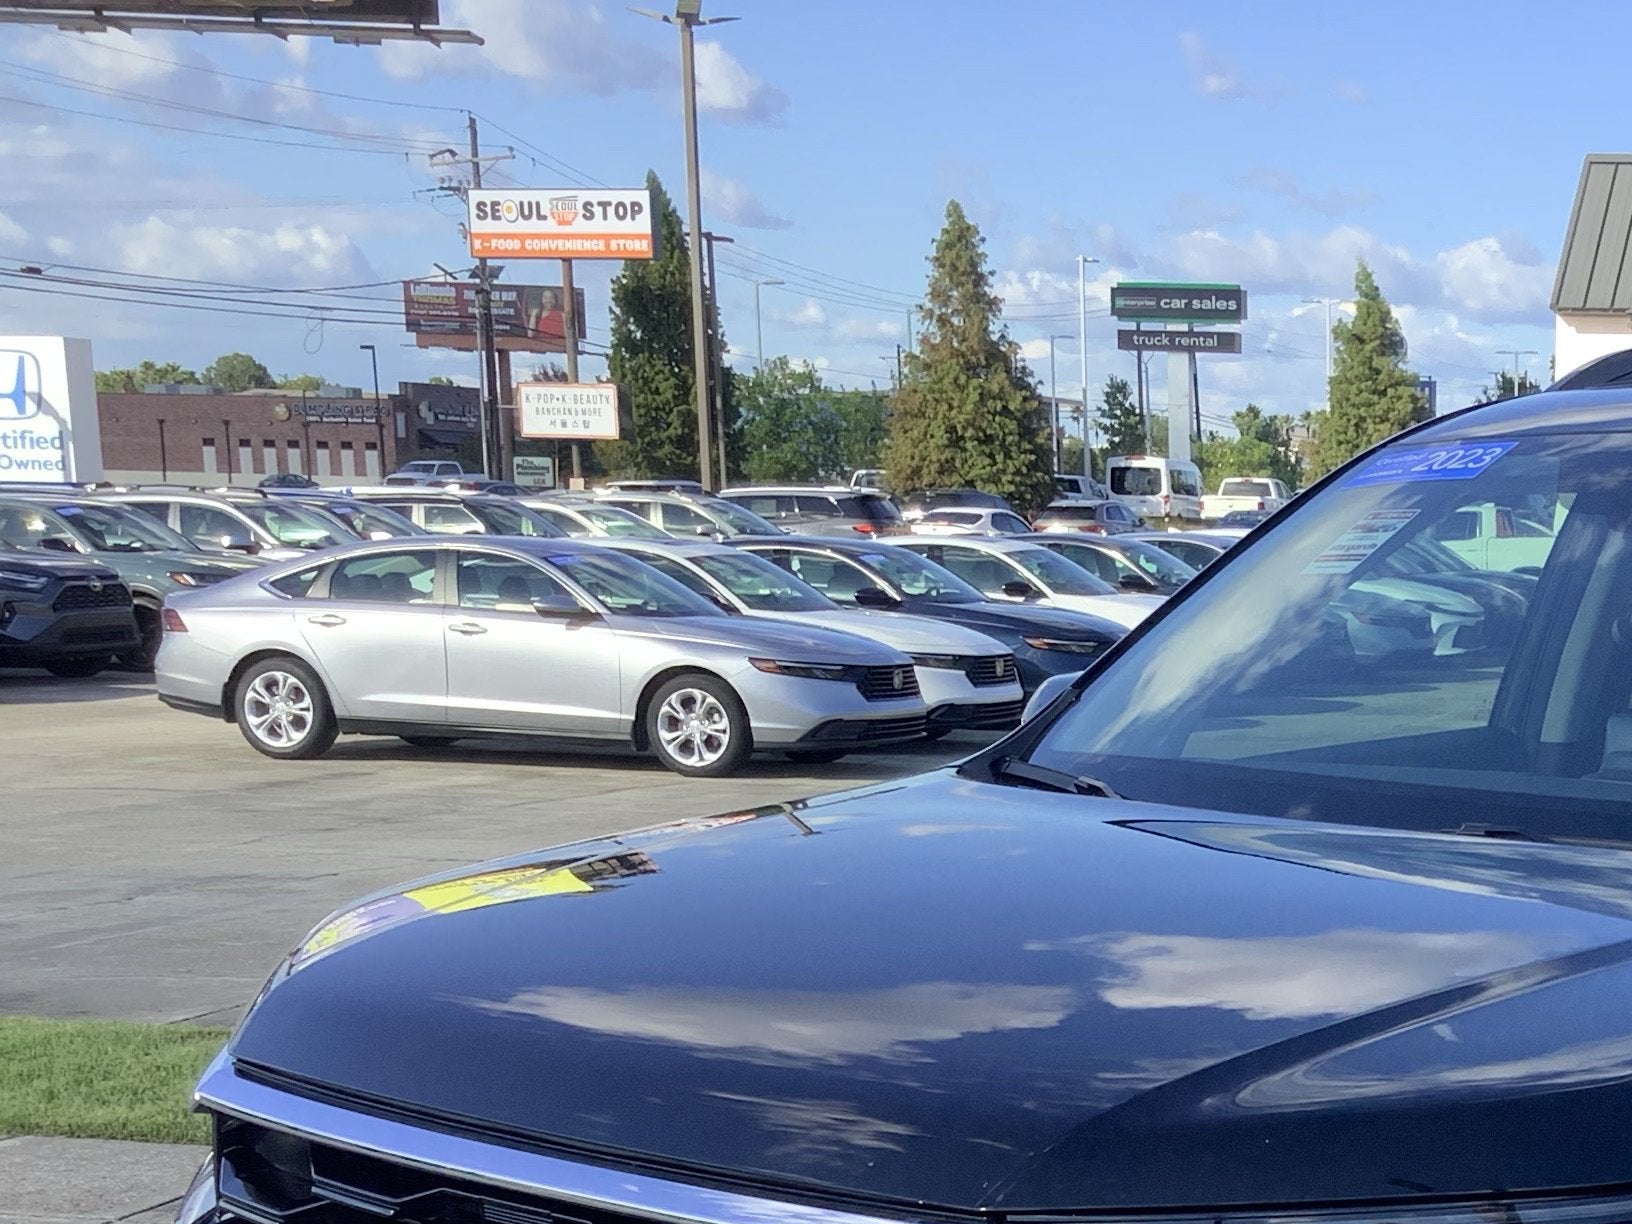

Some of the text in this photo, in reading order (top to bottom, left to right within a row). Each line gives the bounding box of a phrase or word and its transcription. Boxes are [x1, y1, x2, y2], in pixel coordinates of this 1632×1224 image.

[475, 199, 644, 223] SEOUL STOP
[474, 238, 649, 251] K-FOOD CONVENIENCE STORE
[1160, 298, 1189, 310] car
[1191, 295, 1238, 311] sales
[1132, 333, 1219, 348] truck rental
[581, 407, 602, 417] MORE
[0, 453, 67, 472] Owned
[1411, 446, 1503, 472] 2023
